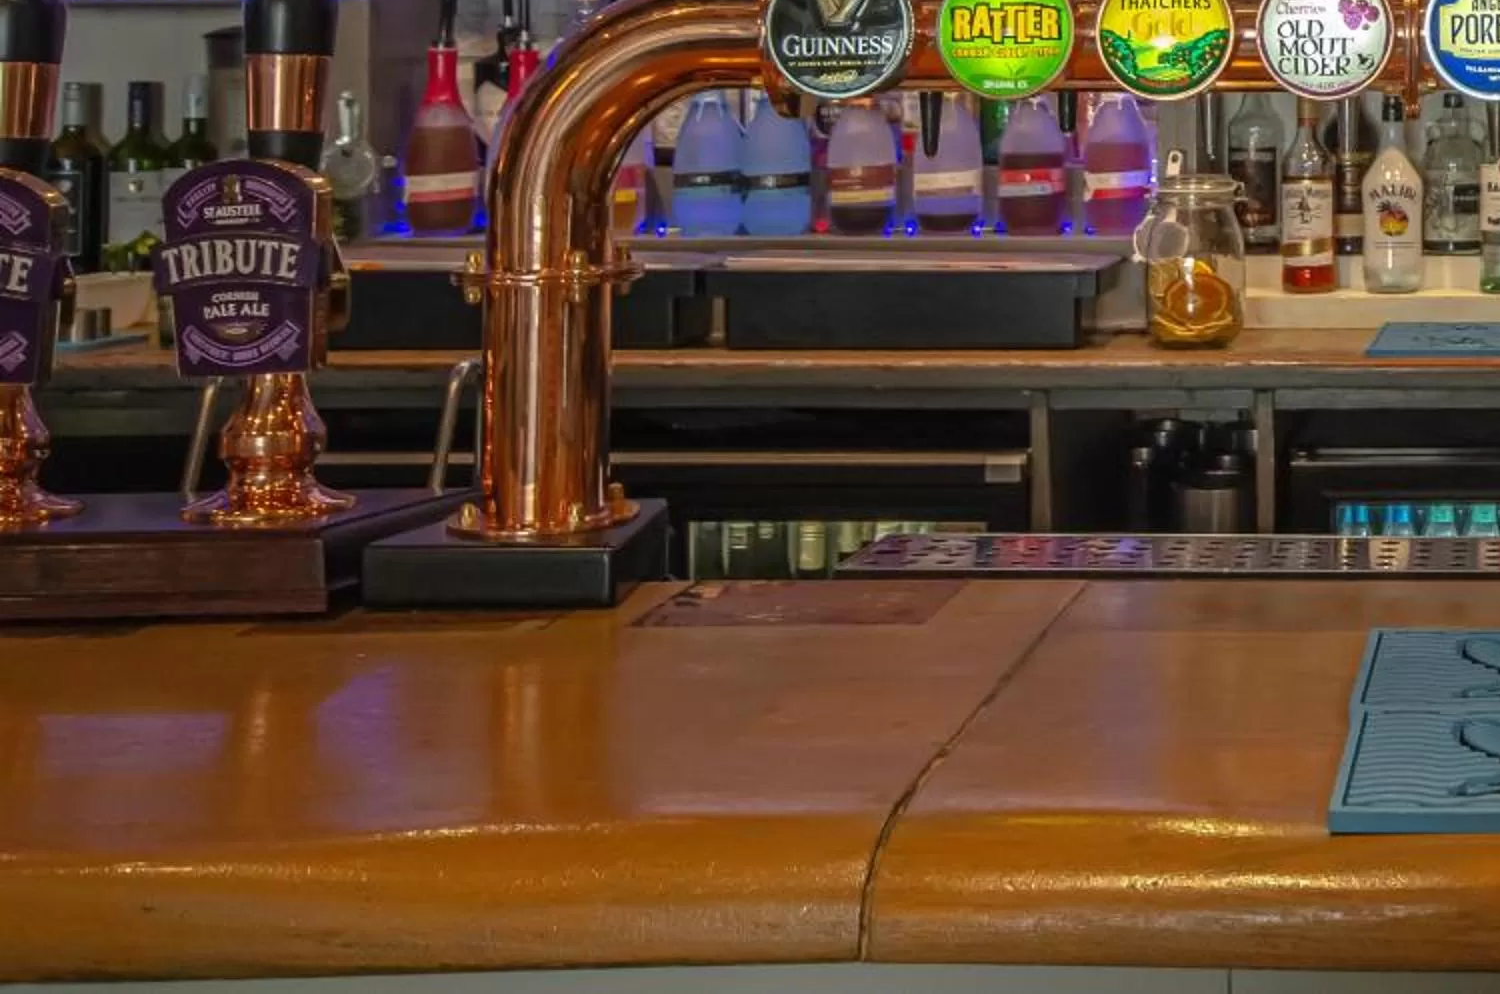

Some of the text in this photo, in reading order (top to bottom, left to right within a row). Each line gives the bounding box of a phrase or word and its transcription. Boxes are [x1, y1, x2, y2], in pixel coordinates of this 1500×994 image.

[951, 2, 1062, 44] RATTLER
[1277, 19, 1324, 38] OLD
[781, 34, 893, 57] GUINNESS
[1279, 37, 1355, 56] MOUT
[1277, 57, 1351, 76] CIDER
[161, 238, 302, 285] TRIBUTE
[203, 303, 270, 320] PALE ALE
